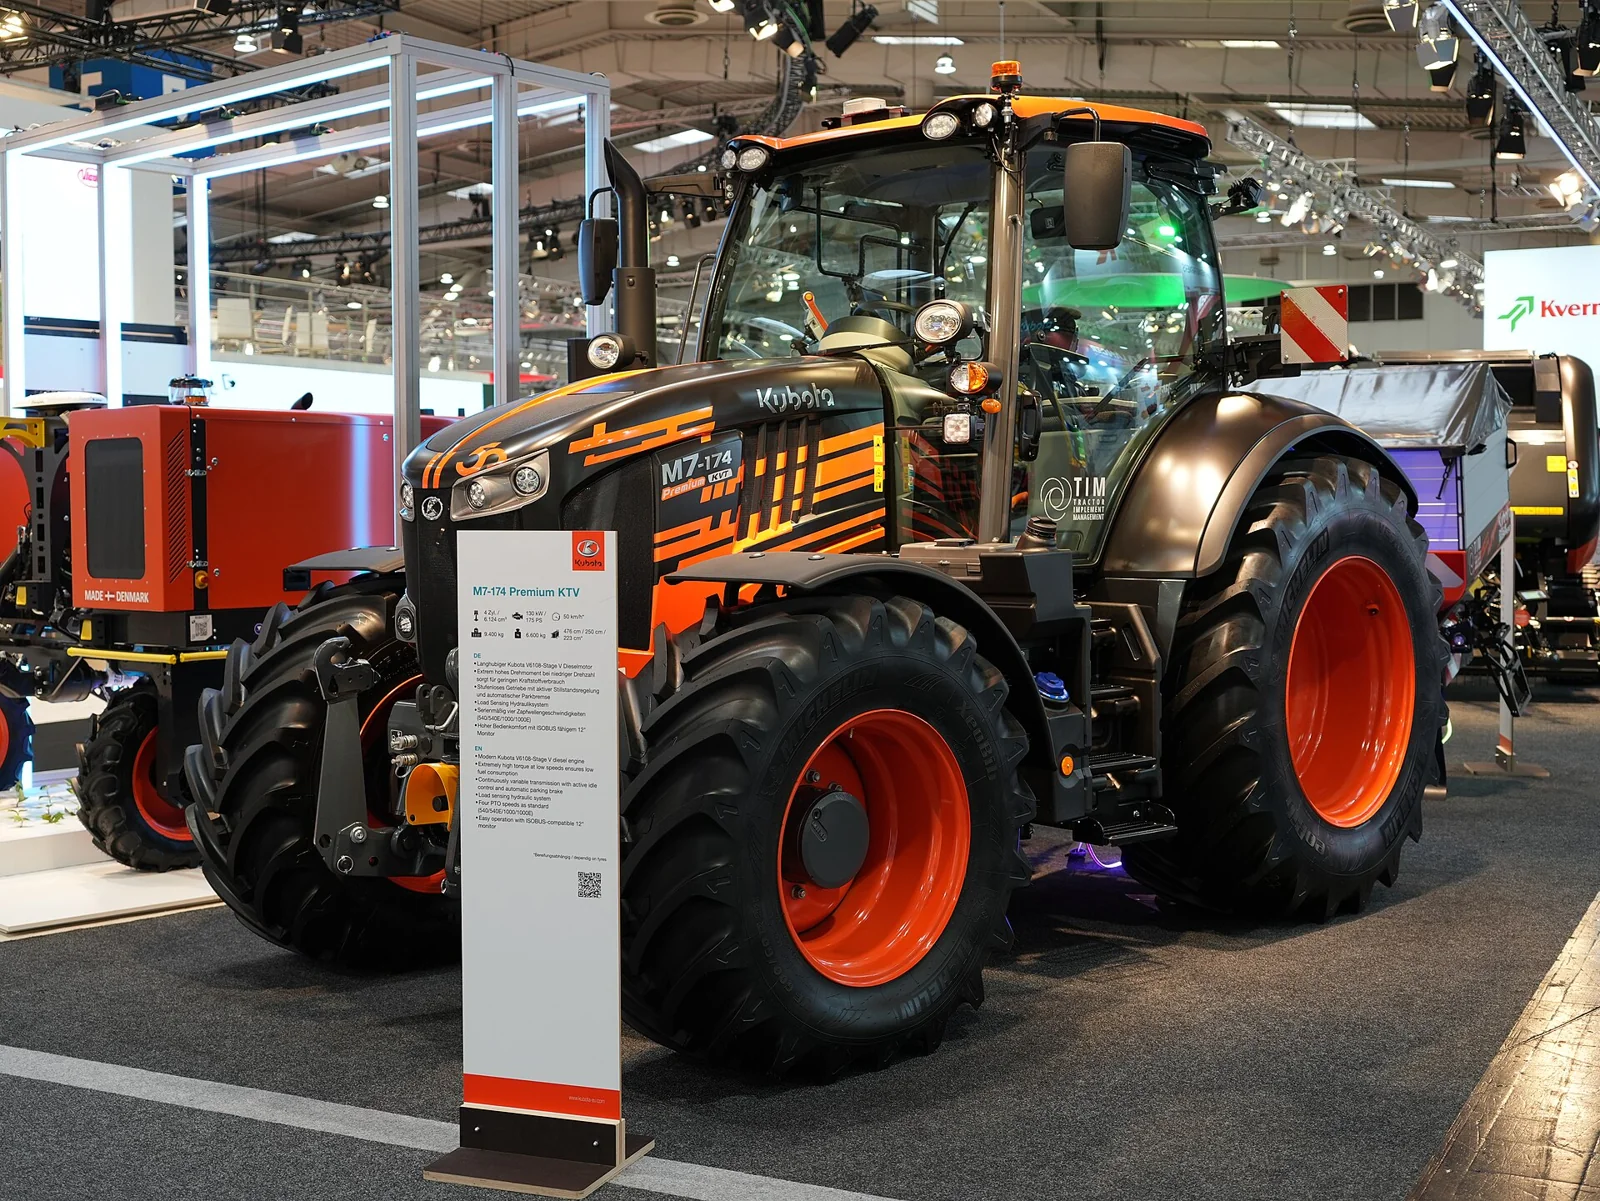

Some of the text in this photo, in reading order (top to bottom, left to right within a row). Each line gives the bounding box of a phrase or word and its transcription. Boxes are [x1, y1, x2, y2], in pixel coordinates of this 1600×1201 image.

[756, 382, 835, 414] Kubota
[661, 450, 732, 486] M7-174
[662, 470, 730, 500] Premium KVT
[1074, 476, 1106, 497] TIM
[574, 558, 602, 567] Kubota
[84, 590, 150, 603] MADE DENMARK
[472, 586, 580, 597] M7-174 Premium KTV
[781, 667, 877, 762] MICHELIN
